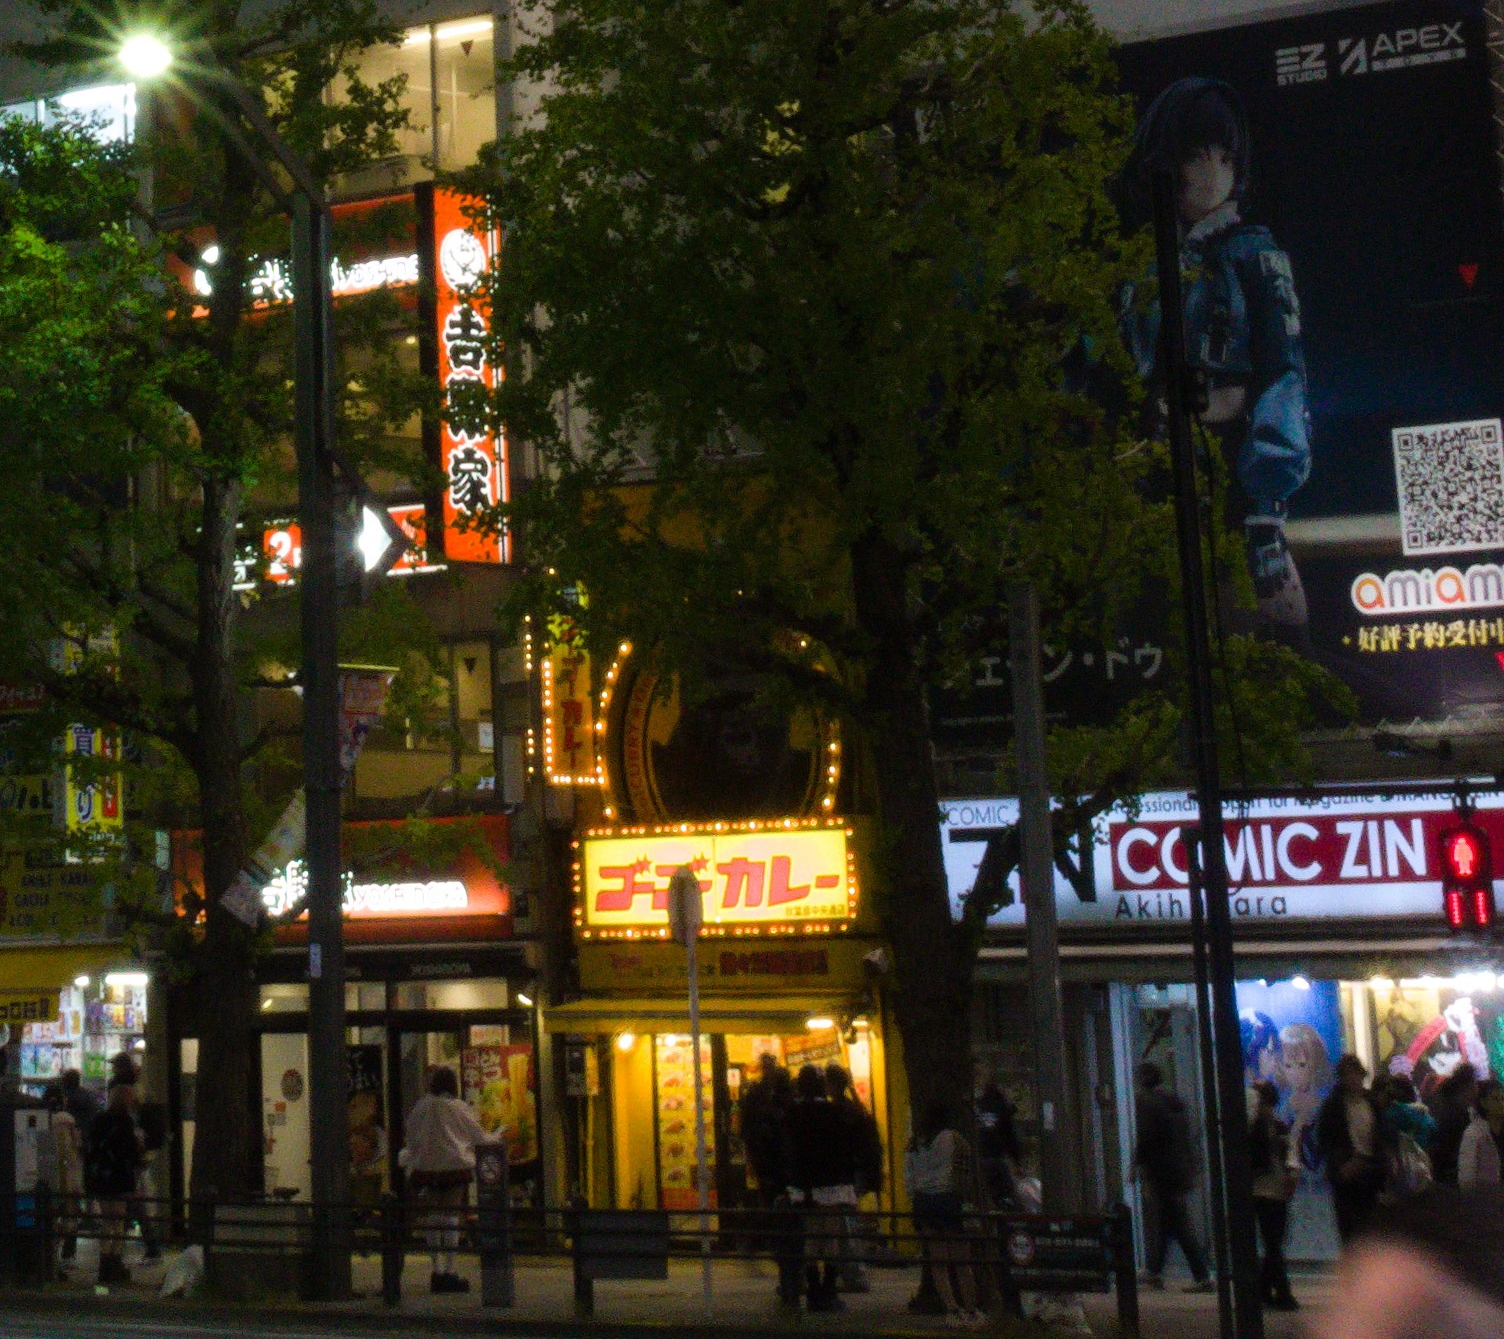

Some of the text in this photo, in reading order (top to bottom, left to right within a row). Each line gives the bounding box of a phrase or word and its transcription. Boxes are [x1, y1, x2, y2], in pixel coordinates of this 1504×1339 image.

[1371, 22, 1464, 59] APEX
[1277, 67, 1328, 87] STUDIO
[442, 303, 493, 516] 吉家
[948, 805, 1010, 827] COMIC
[1335, 818, 1427, 878] ZIN
[1115, 886, 1289, 921] Akihara
